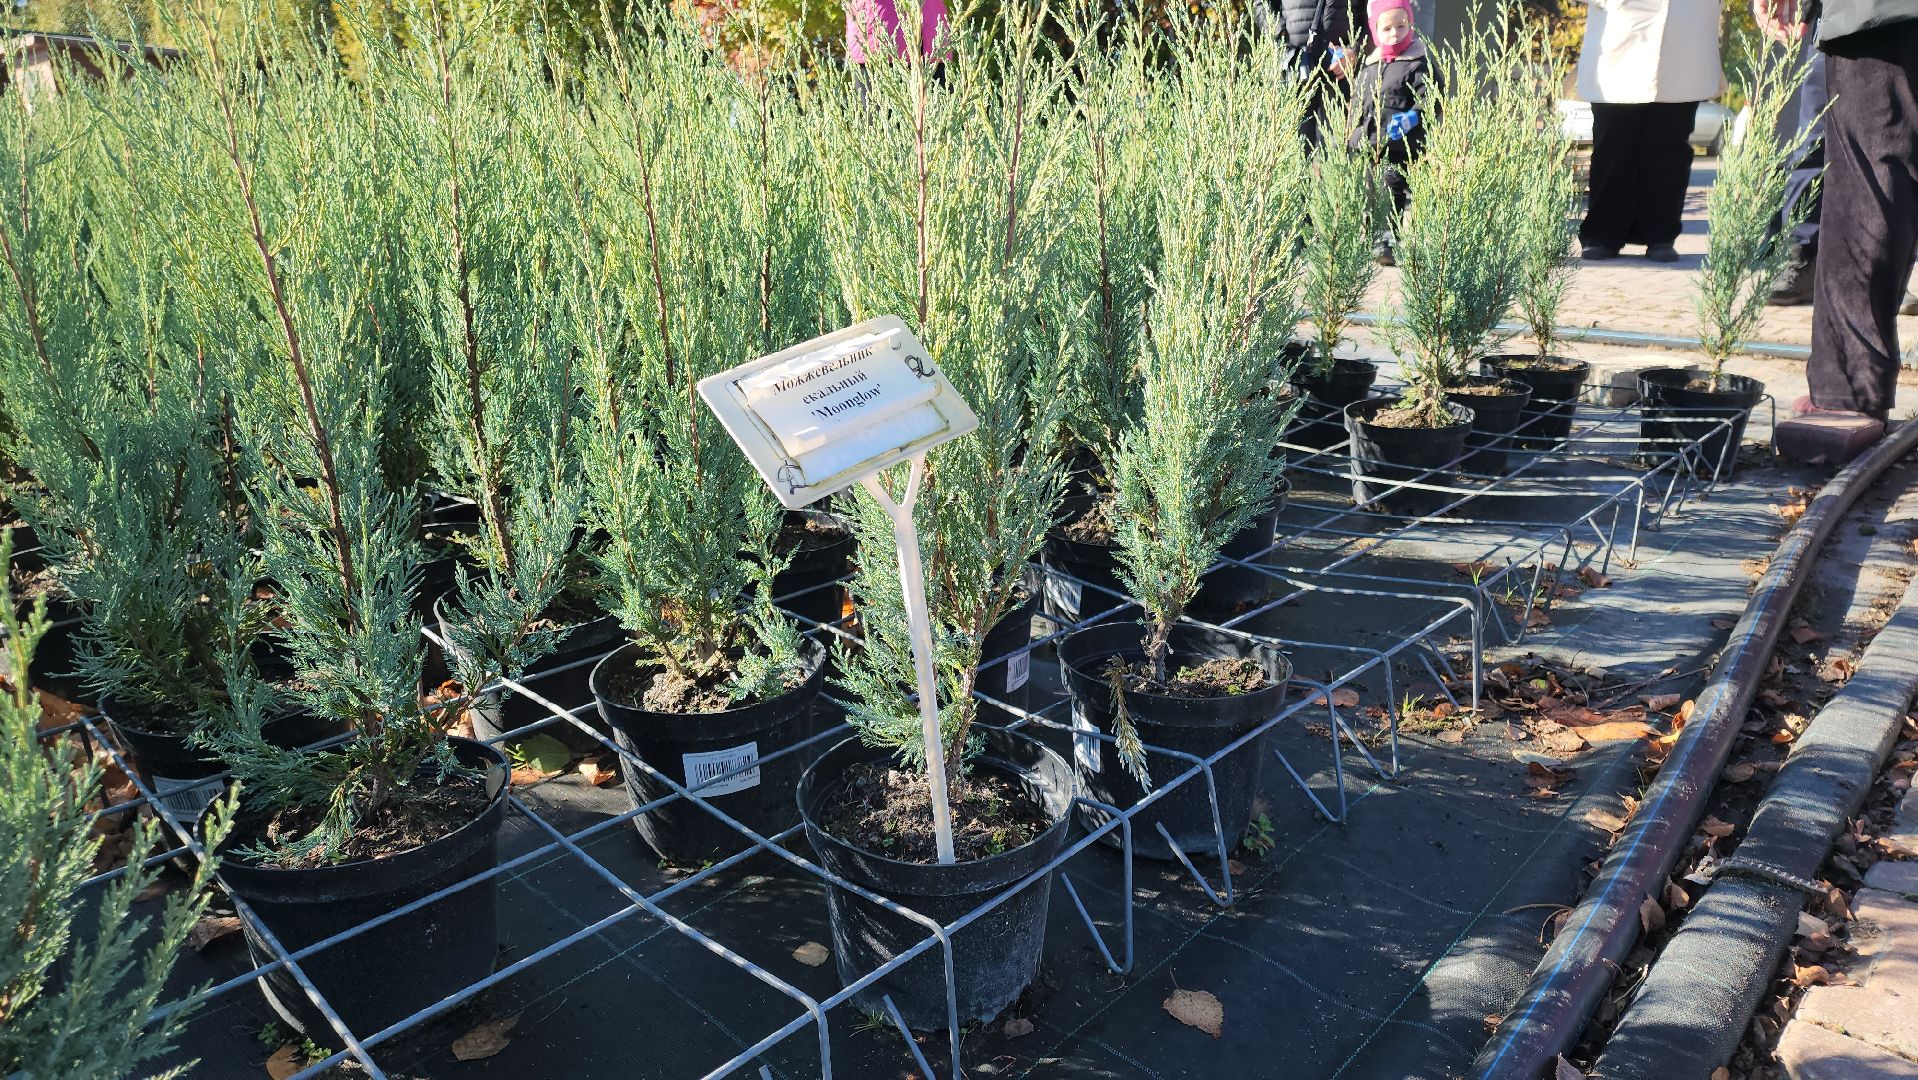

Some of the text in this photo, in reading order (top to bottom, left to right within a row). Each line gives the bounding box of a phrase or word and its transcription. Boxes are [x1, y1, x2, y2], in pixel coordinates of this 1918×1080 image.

[773, 346, 873, 395] Можжевельник
[803, 370, 868, 405] скальный
[811, 383, 881, 421] 'Moonglow'
